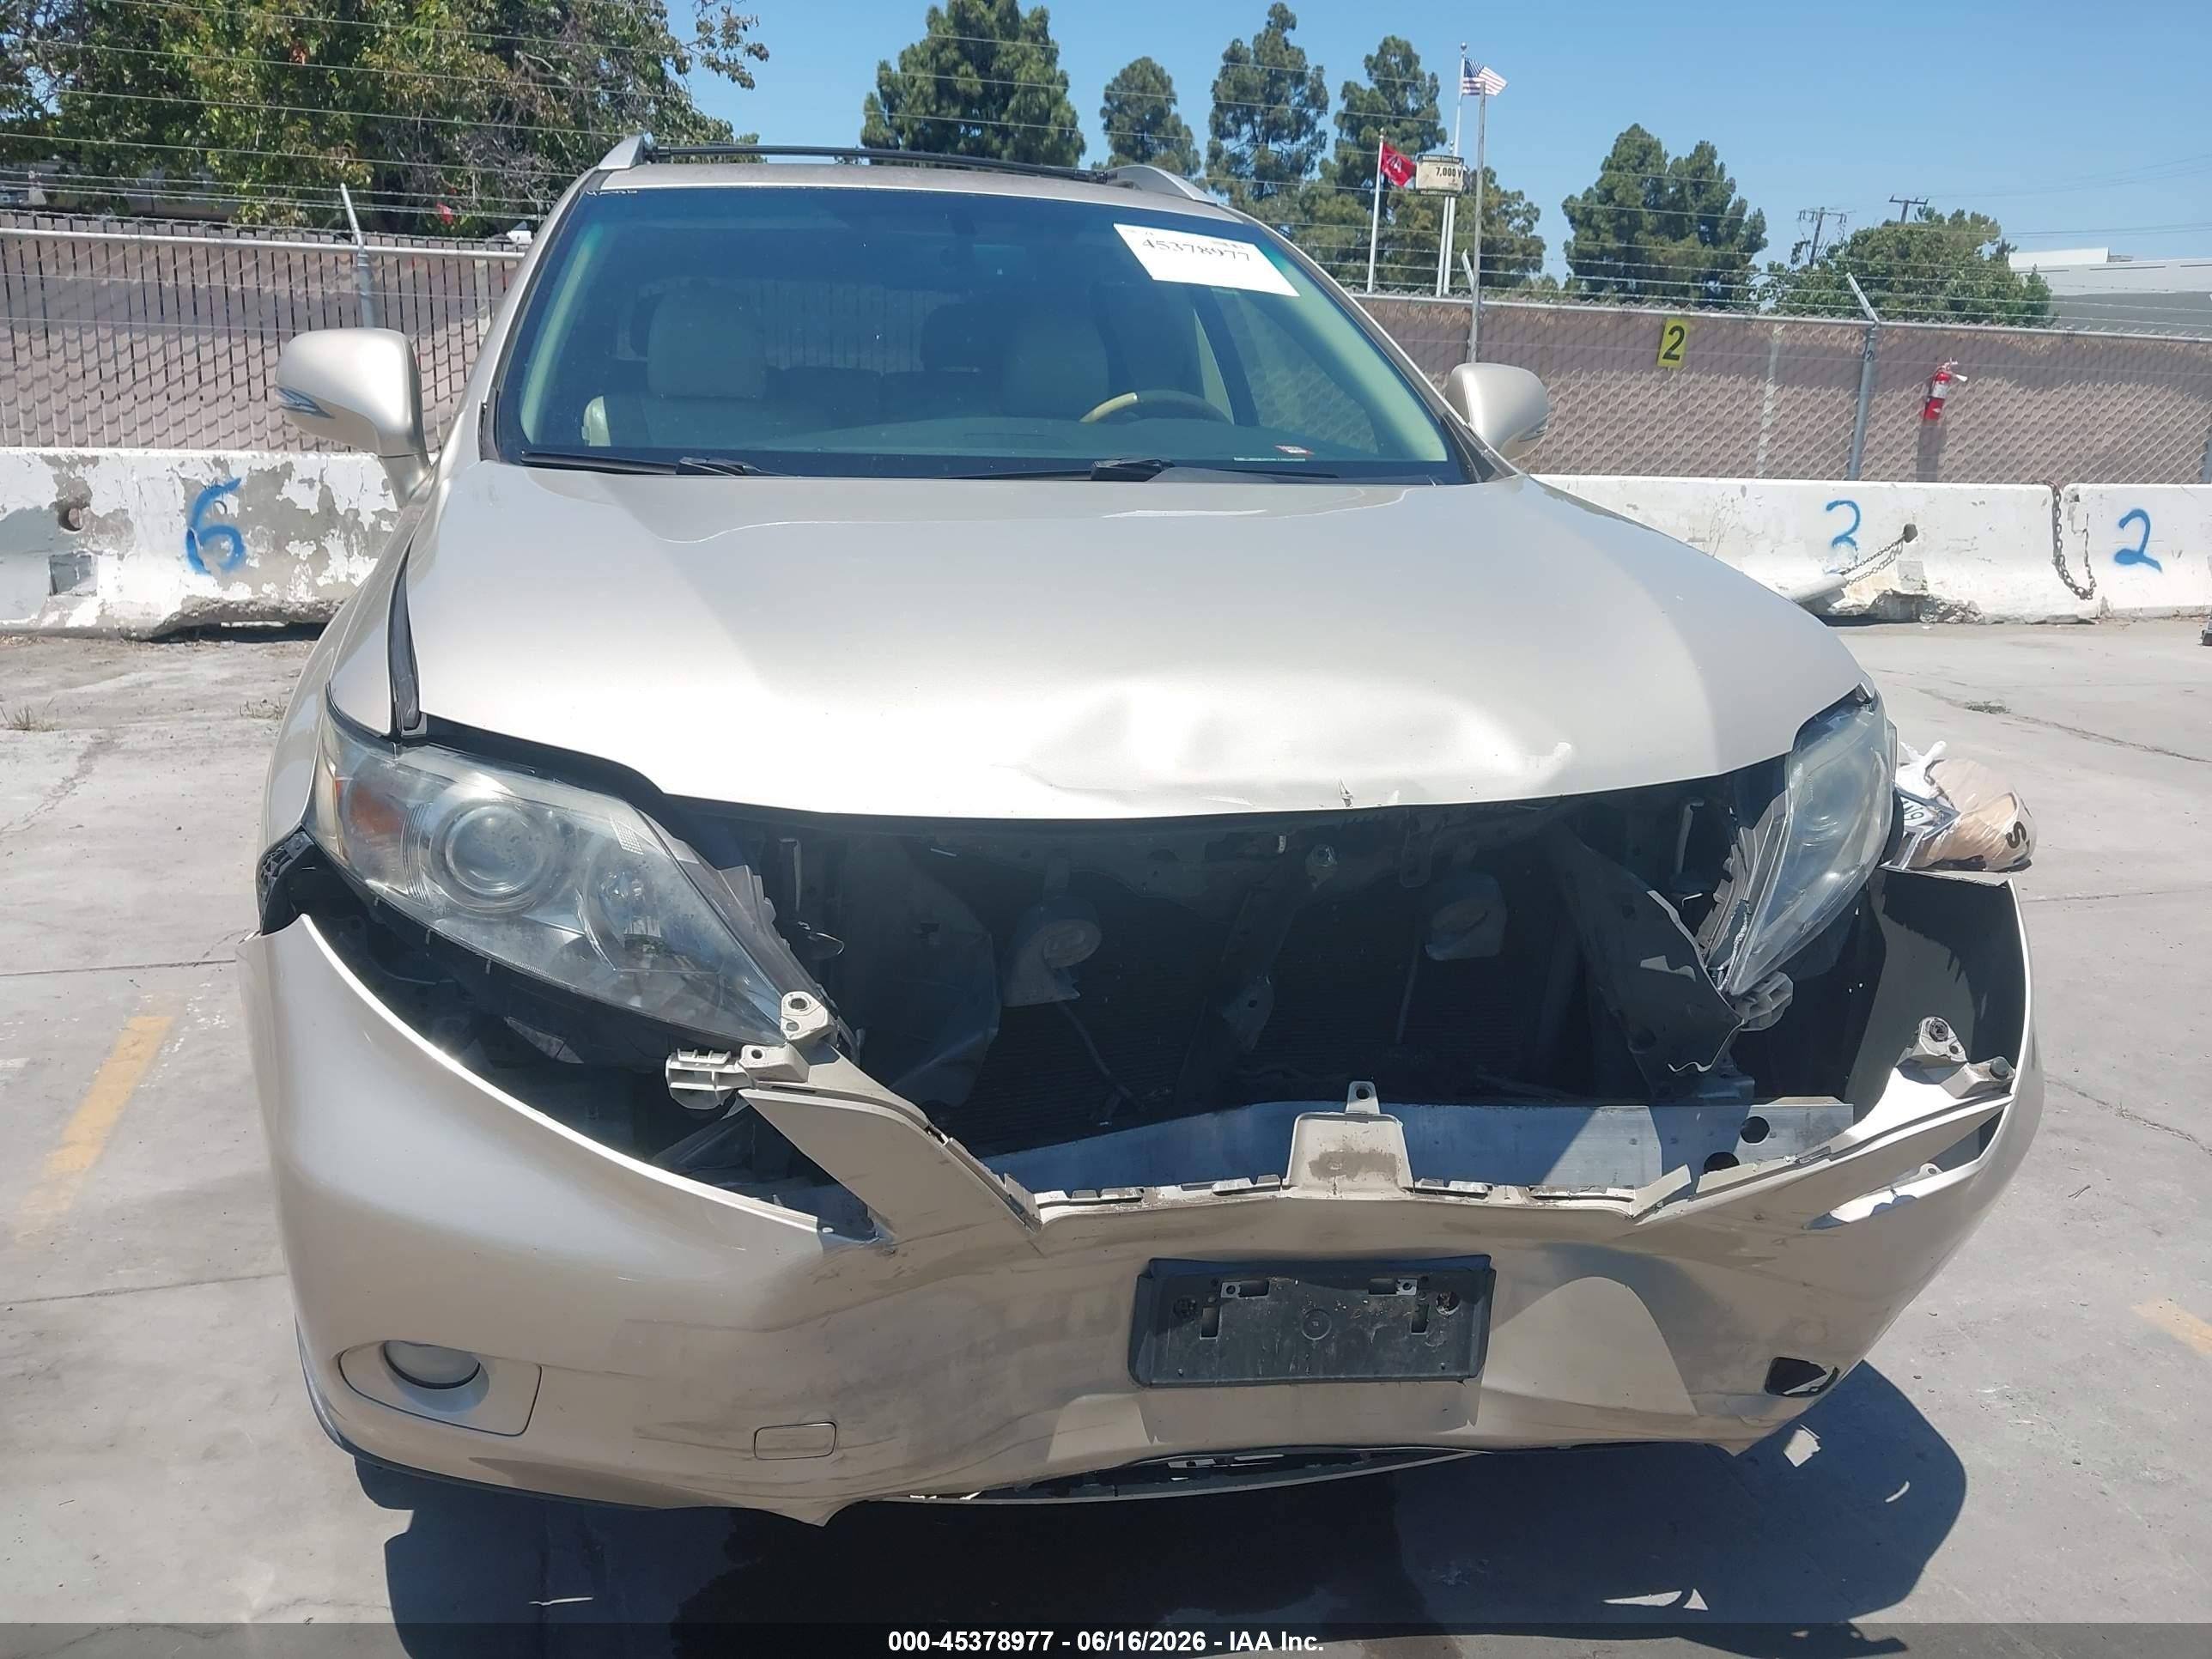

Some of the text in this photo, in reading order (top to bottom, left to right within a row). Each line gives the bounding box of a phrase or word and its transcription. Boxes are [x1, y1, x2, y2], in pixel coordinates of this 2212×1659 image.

[1142, 239, 1250, 261] 45378977
[1662, 325, 1685, 361] 2
[185, 477, 245, 574] 6
[1826, 500, 1861, 548] 2
[2114, 508, 2163, 573] 2
